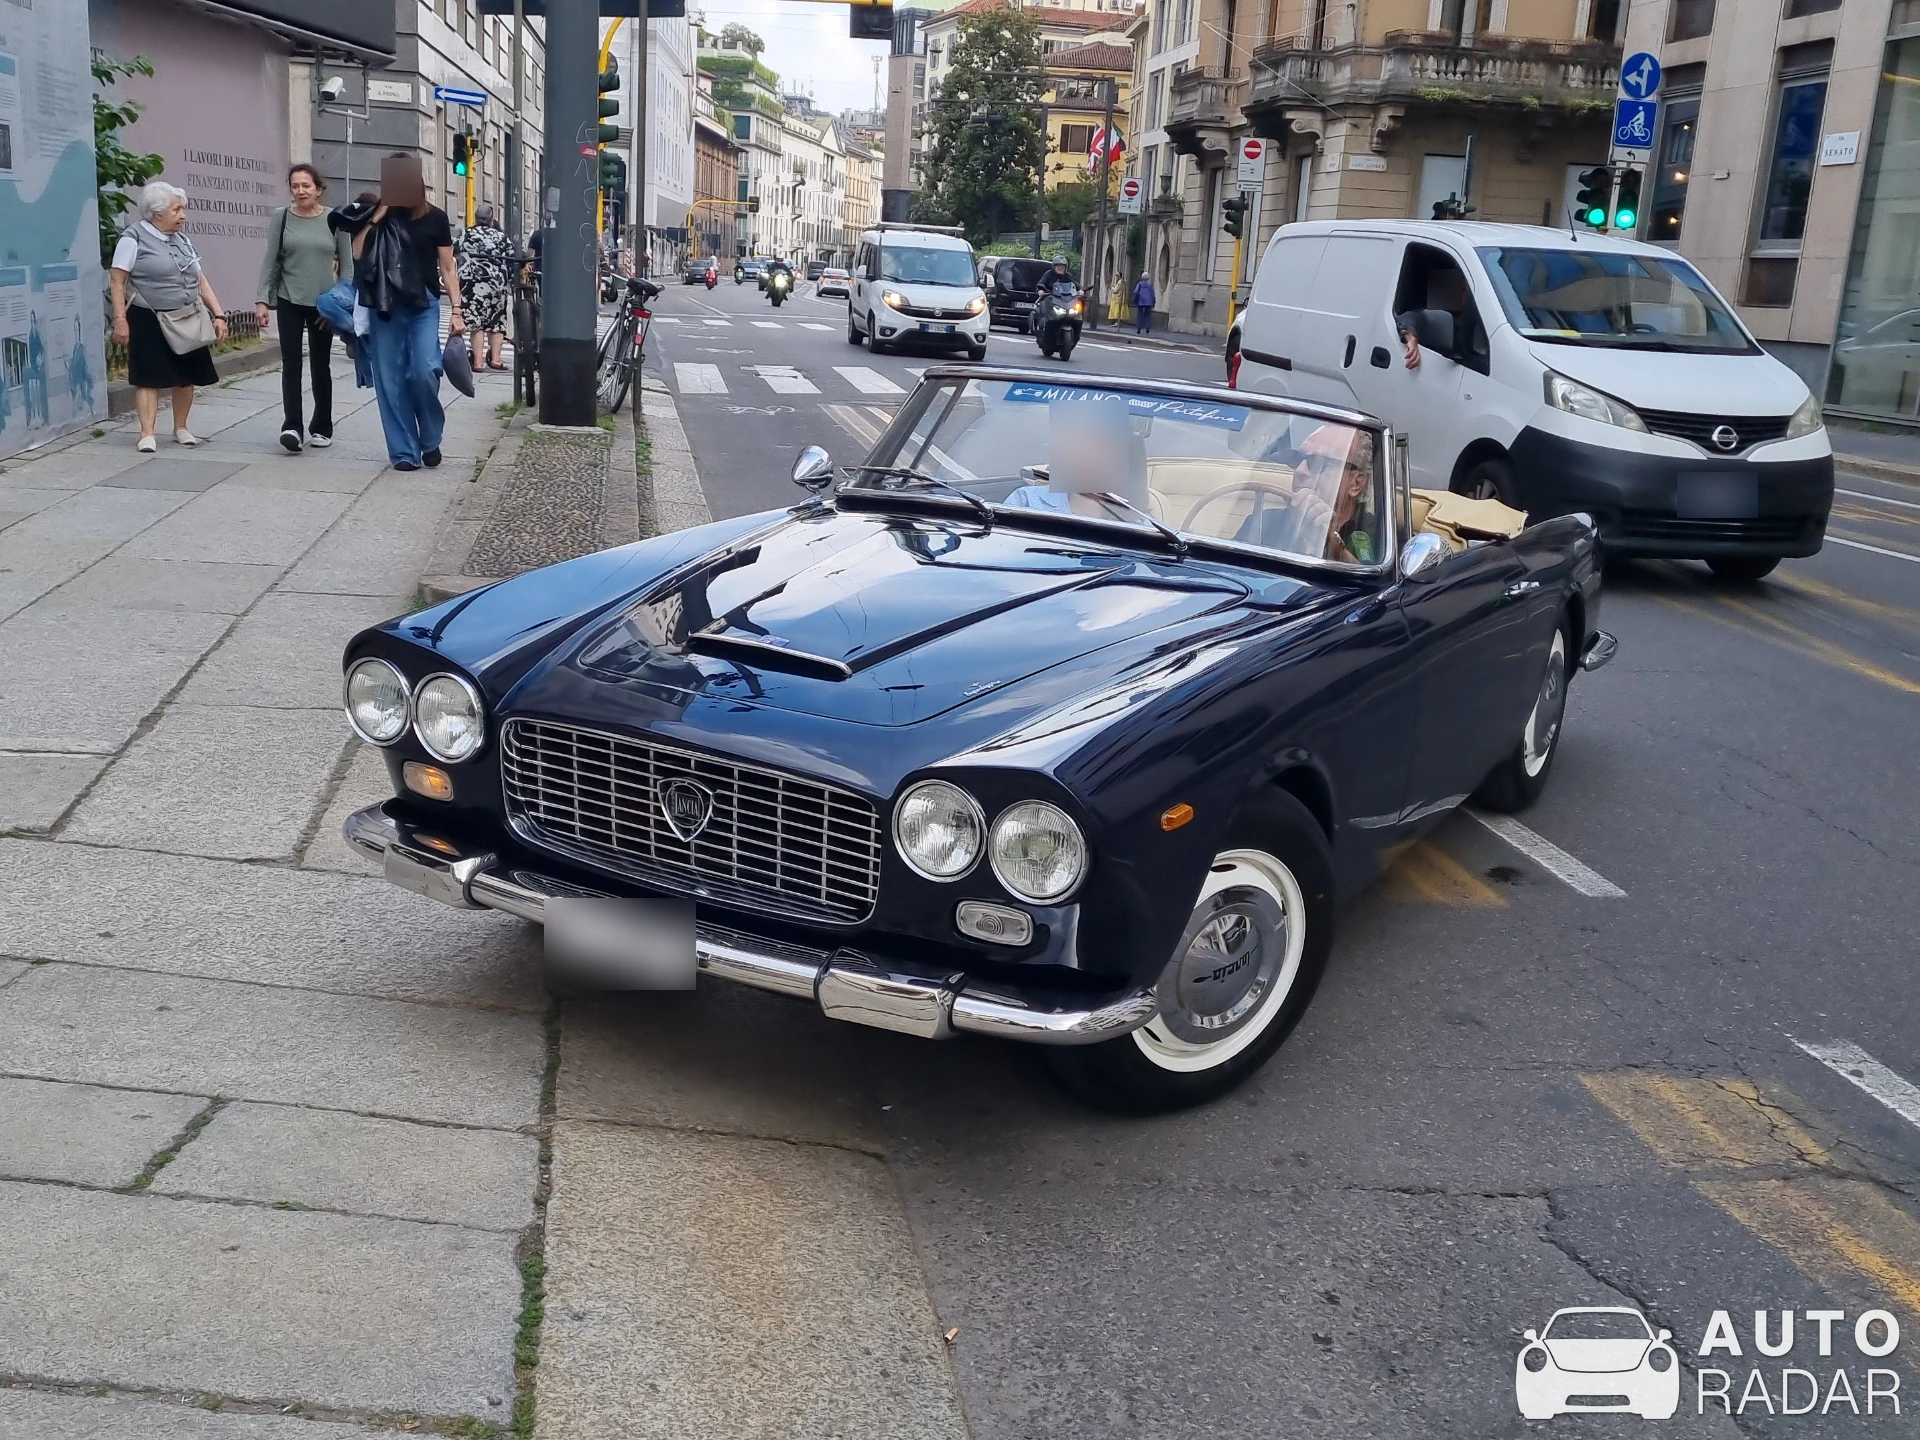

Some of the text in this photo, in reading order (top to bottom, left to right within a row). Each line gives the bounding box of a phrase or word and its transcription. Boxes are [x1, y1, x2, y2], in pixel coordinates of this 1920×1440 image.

[184, 149, 187, 162] I
[190, 150, 222, 167] LAVORI
[224, 155, 233, 168] DI
[1823, 147, 1854, 158] SENATO
[187, 173, 233, 191] FINANZIATI
[234, 179, 250, 193] CON
[184, 197, 225, 214] ENERATI
[228, 202, 255, 216] DALLA
[181, 220, 226, 237] RASMESSA
[227, 224, 238, 237] SU
[1153, 401, 1239, 422] Portofino
[674, 792, 699, 816] LANCIA
